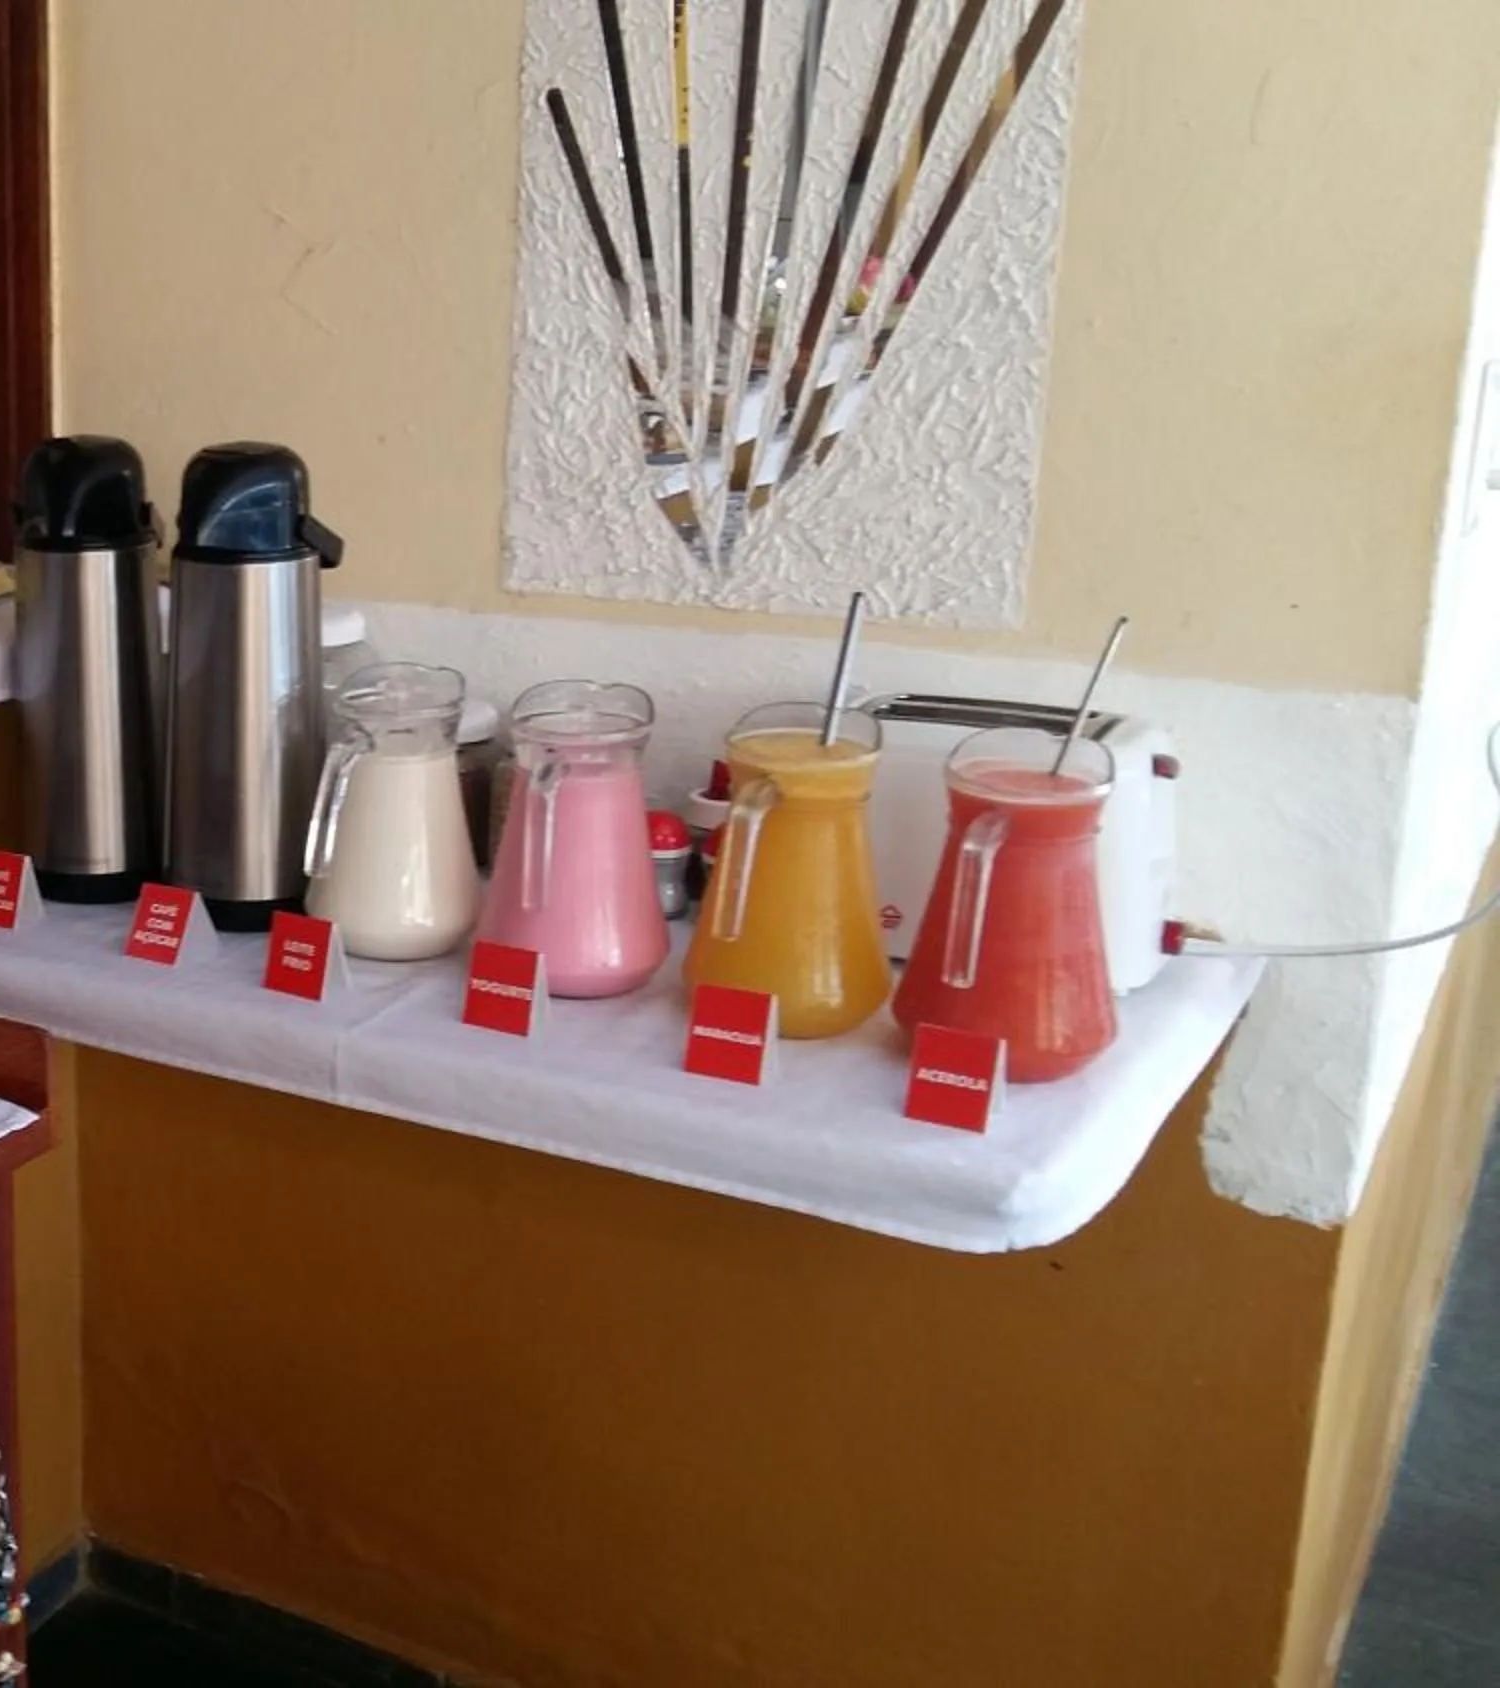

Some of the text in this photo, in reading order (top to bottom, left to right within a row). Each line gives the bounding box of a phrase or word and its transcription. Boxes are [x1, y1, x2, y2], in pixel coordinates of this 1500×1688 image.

[146, 917, 175, 931] COM
[282, 939, 317, 957] LEITE
[281, 955, 313, 971] FRIO
[915, 1067, 989, 1093] ACEROLA
